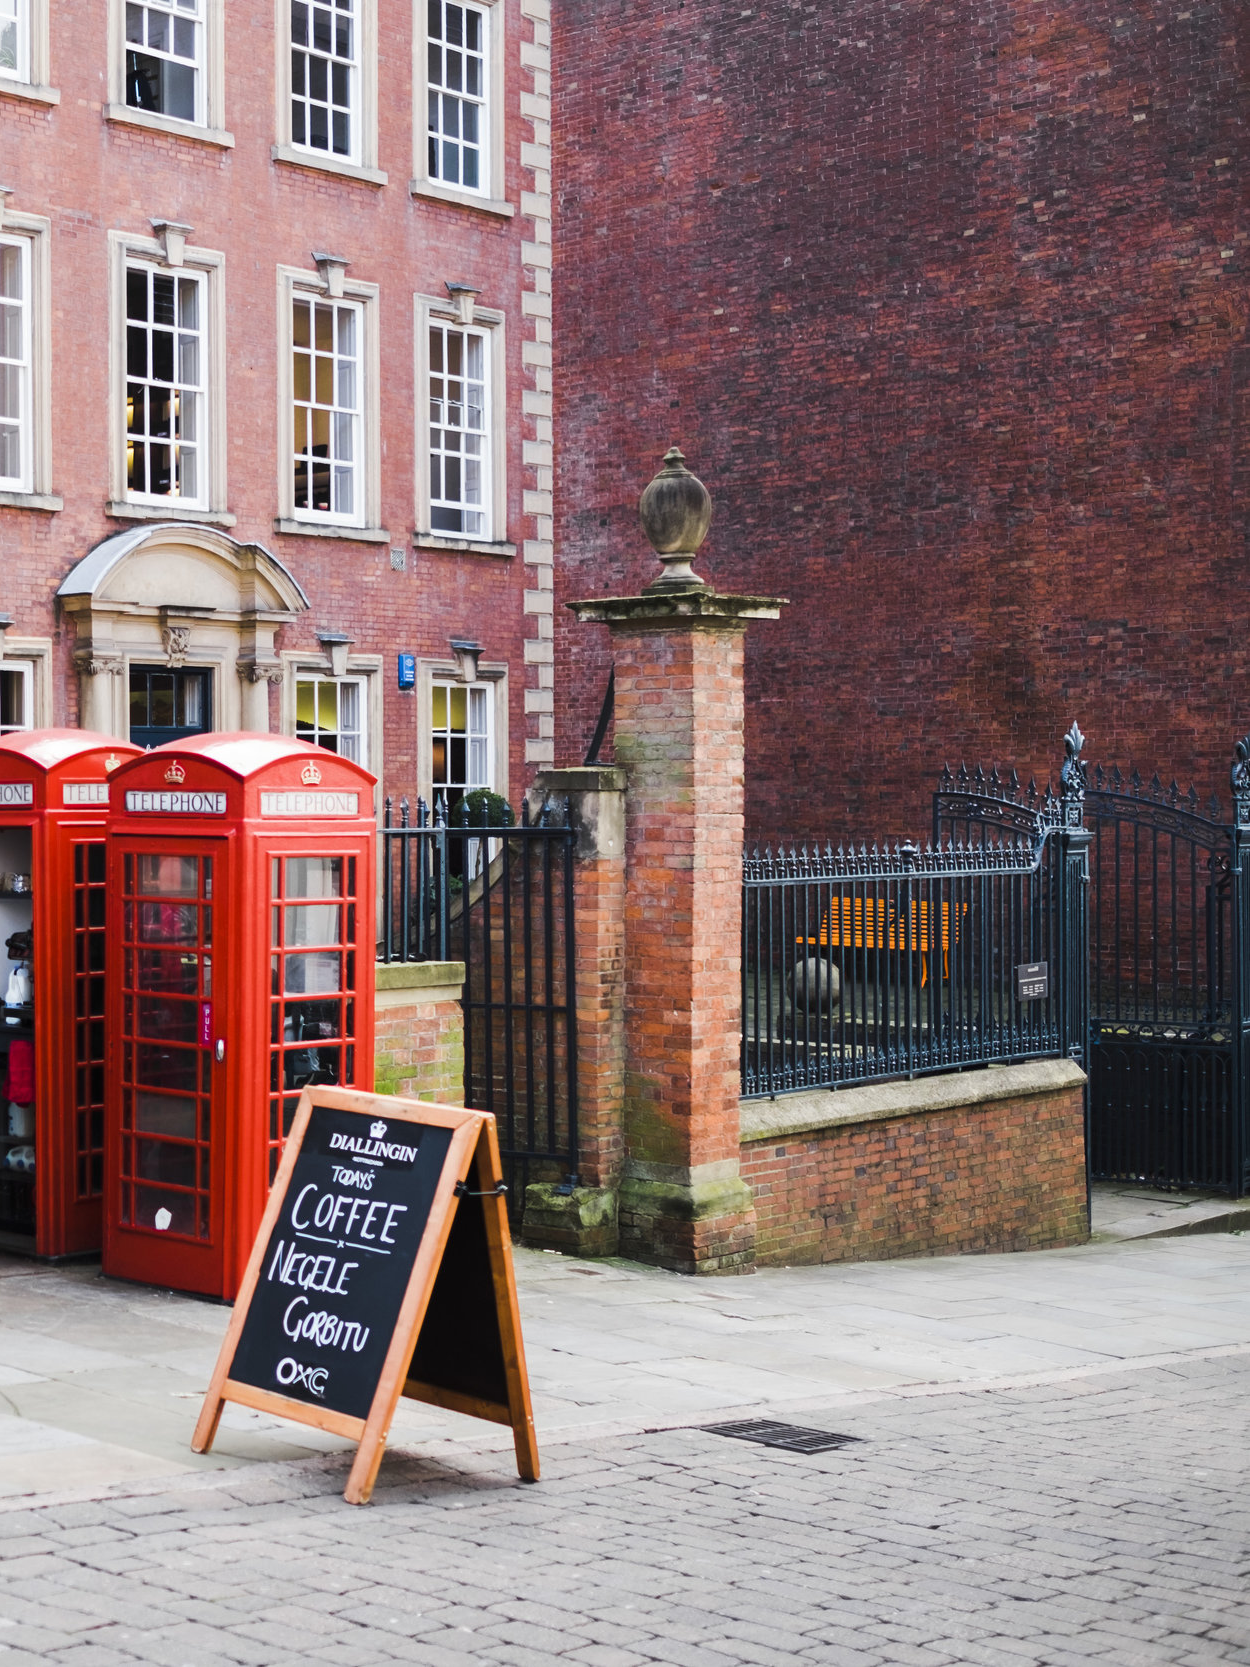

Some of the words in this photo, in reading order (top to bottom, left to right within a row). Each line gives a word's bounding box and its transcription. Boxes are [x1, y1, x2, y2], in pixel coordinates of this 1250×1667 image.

[67, 785, 105, 801] TELE
[130, 793, 224, 812] TELEPHONE
[265, 794, 354, 813] TELEPHONE
[329, 1132, 418, 1163] DIALLINGIN
[291, 1183, 408, 1244] COFFEE
[267, 1239, 359, 1296] NEGELE
[282, 1295, 370, 1353] GORBITU
